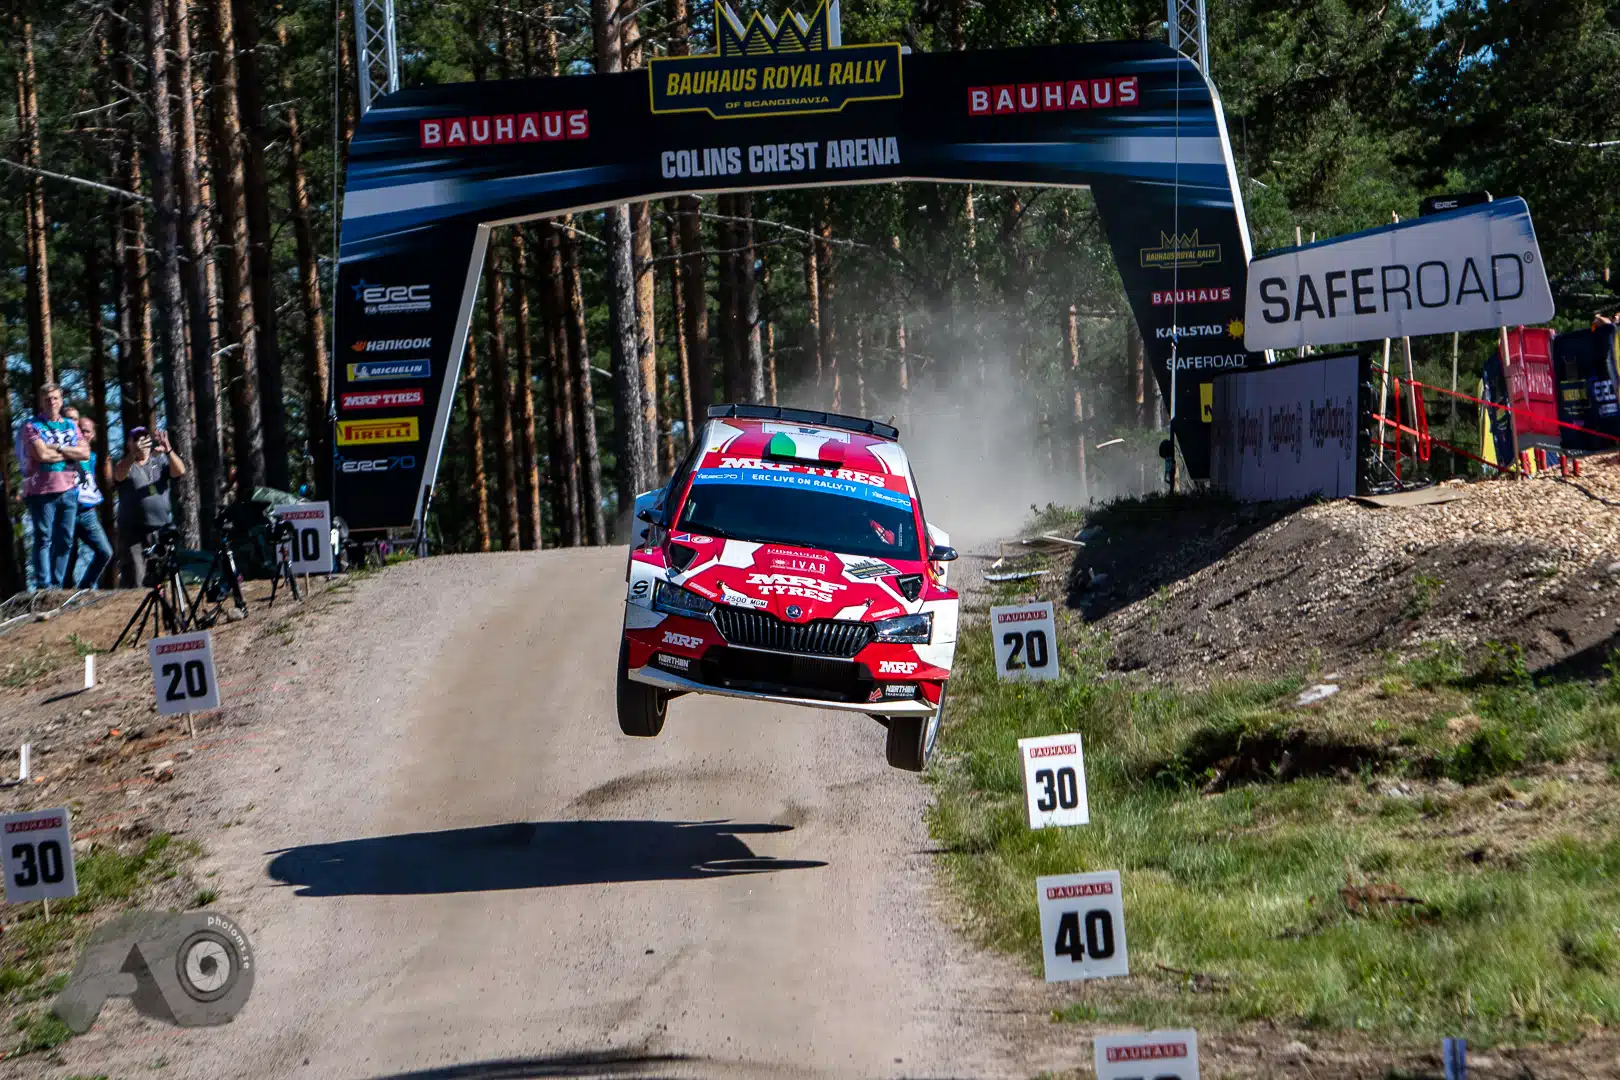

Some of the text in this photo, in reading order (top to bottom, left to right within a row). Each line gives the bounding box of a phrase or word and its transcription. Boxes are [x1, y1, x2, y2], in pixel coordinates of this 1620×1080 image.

[666, 59, 887, 96] BAUHAUS ROYAL RALLY
[743, 96, 829, 108] SCANDINAVIA
[972, 81, 1136, 111] BAUHAUS
[424, 113, 587, 144] BAUHAUS
[661, 137, 900, 179] COLINS CREST ARENA
[1153, 288, 1231, 304] BAUHAUS
[1156, 325, 1222, 338] KARLSTAD
[370, 364, 423, 375] MICHELIN
[343, 391, 421, 407] MRF TYRES
[344, 422, 411, 441] PIRELLI
[752, 474, 857, 492] ERC LIVE ON RALLY.TV
[792, 559, 826, 573] IVAR
[746, 573, 848, 593] MRF
[758, 585, 833, 603] TYRES
[998, 610, 1047, 623] BAUHAUS
[661, 631, 703, 649] MRF
[1003, 630, 1049, 671] 20
[879, 660, 918, 674] MRF
[162, 659, 208, 702] 20
[1030, 745, 1076, 758] BAUHAUS
[1035, 766, 1079, 812] 30
[12, 840, 65, 888] 30
[1048, 883, 1113, 899] BAUHAUS
[1055, 908, 1115, 964] 40
[1107, 1043, 1187, 1062] BAUHAUS
